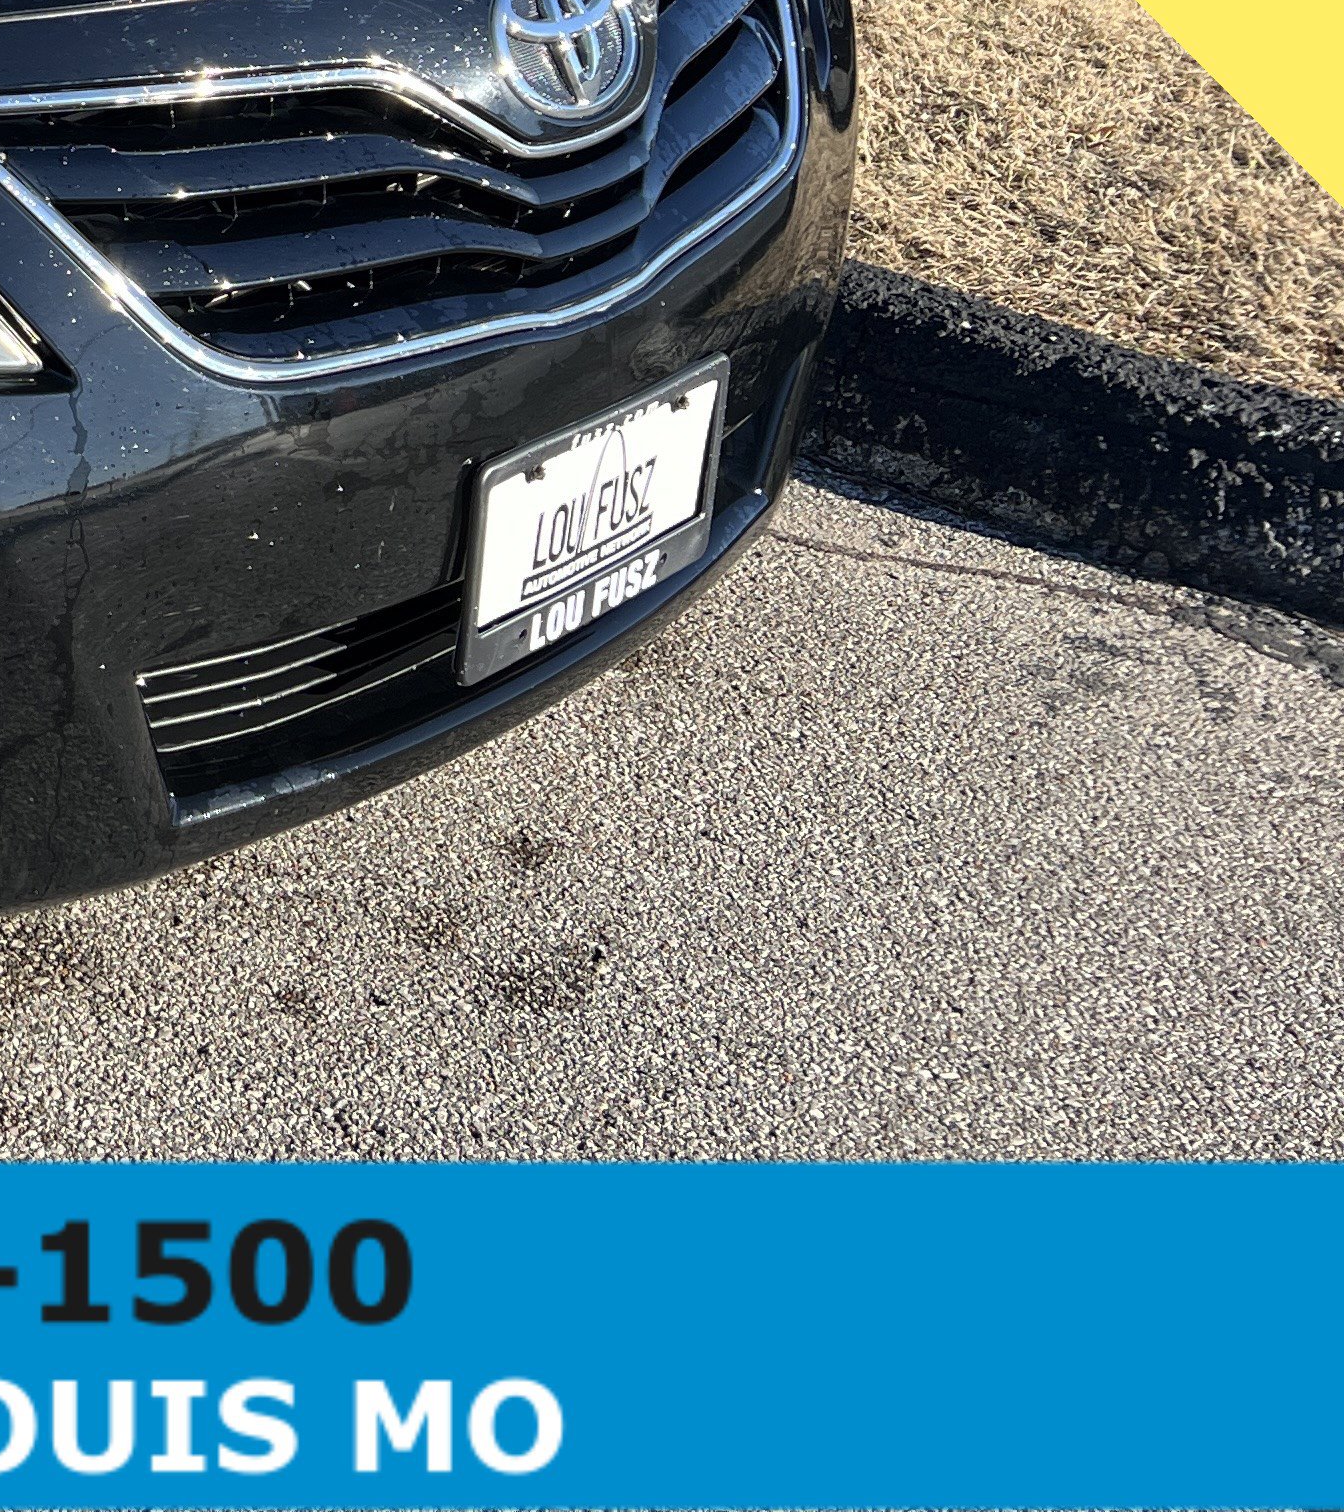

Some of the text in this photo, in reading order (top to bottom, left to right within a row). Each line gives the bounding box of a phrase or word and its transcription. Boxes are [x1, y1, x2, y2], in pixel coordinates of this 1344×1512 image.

[532, 455, 658, 570] LOU FUSZ
[523, 548, 599, 596] AUTOMOTIVE
[529, 547, 661, 652] LOU FUSZ
